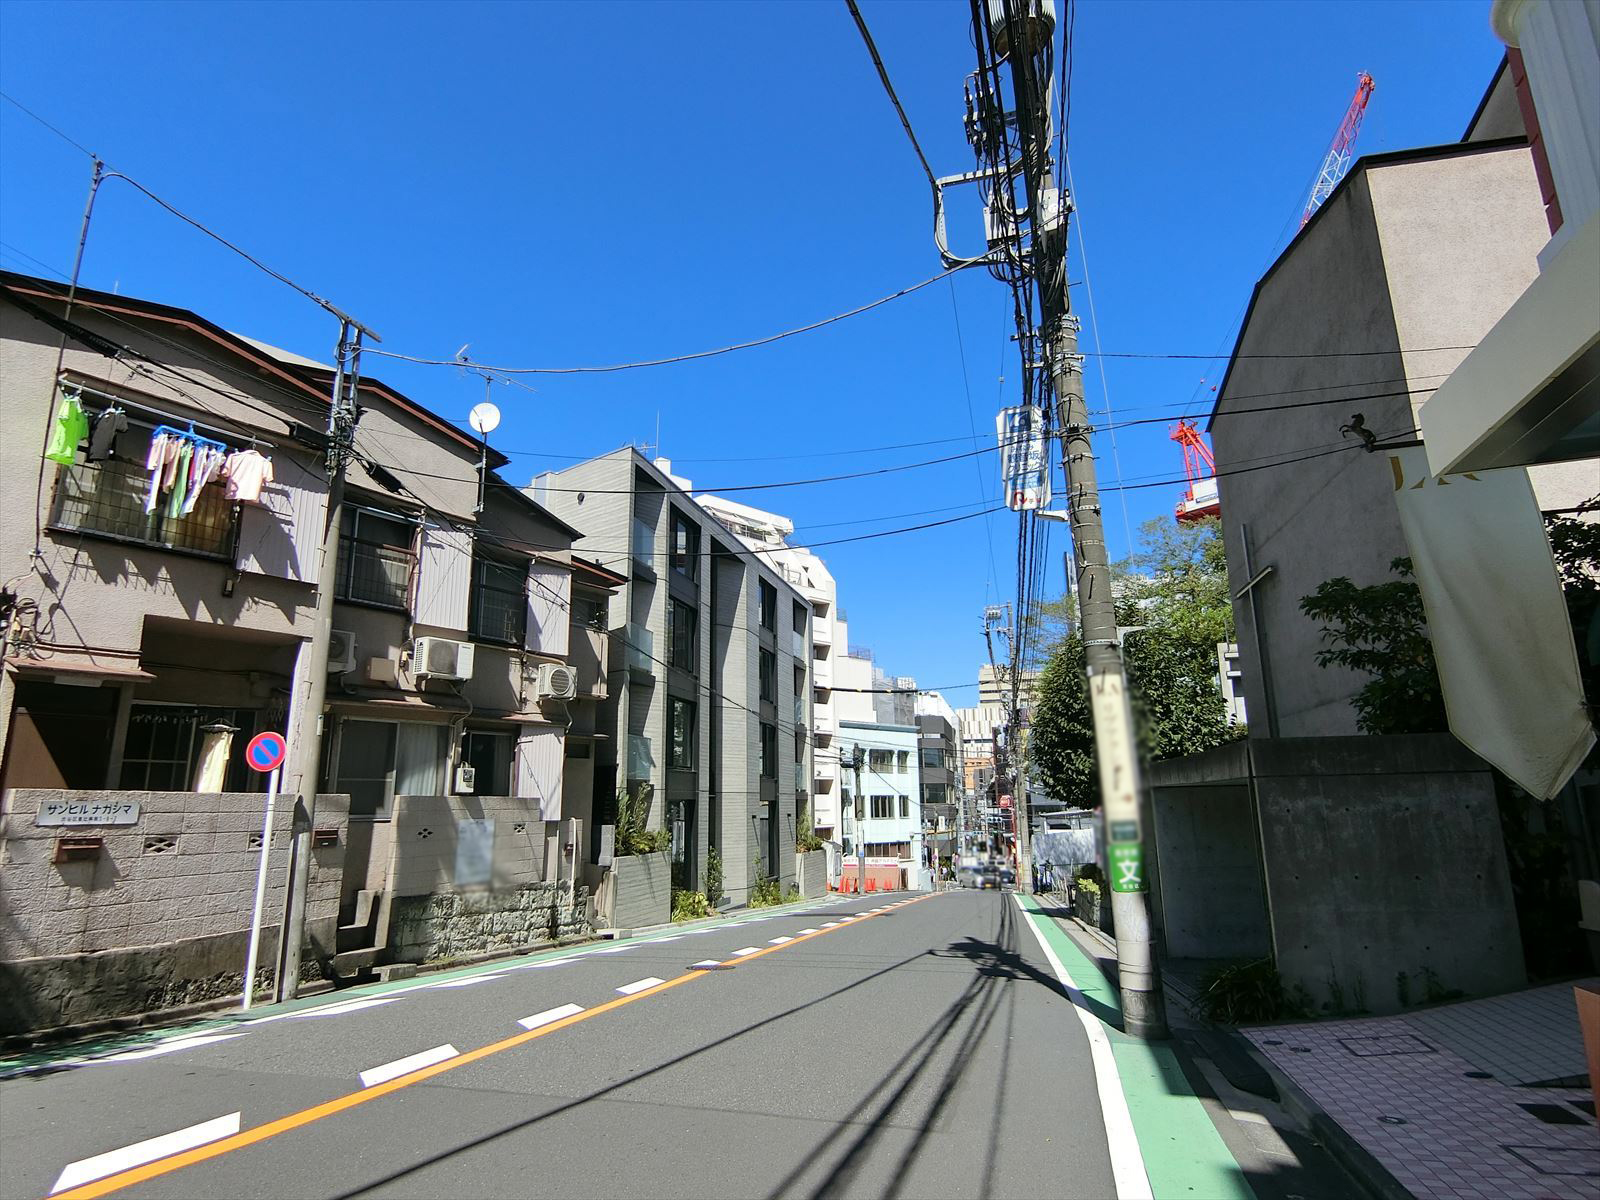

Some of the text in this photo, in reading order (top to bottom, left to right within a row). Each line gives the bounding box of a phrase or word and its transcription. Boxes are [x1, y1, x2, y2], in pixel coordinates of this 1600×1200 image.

[92, 804, 132, 815] ナガシマ
[1117, 859, 1142, 884] 文
